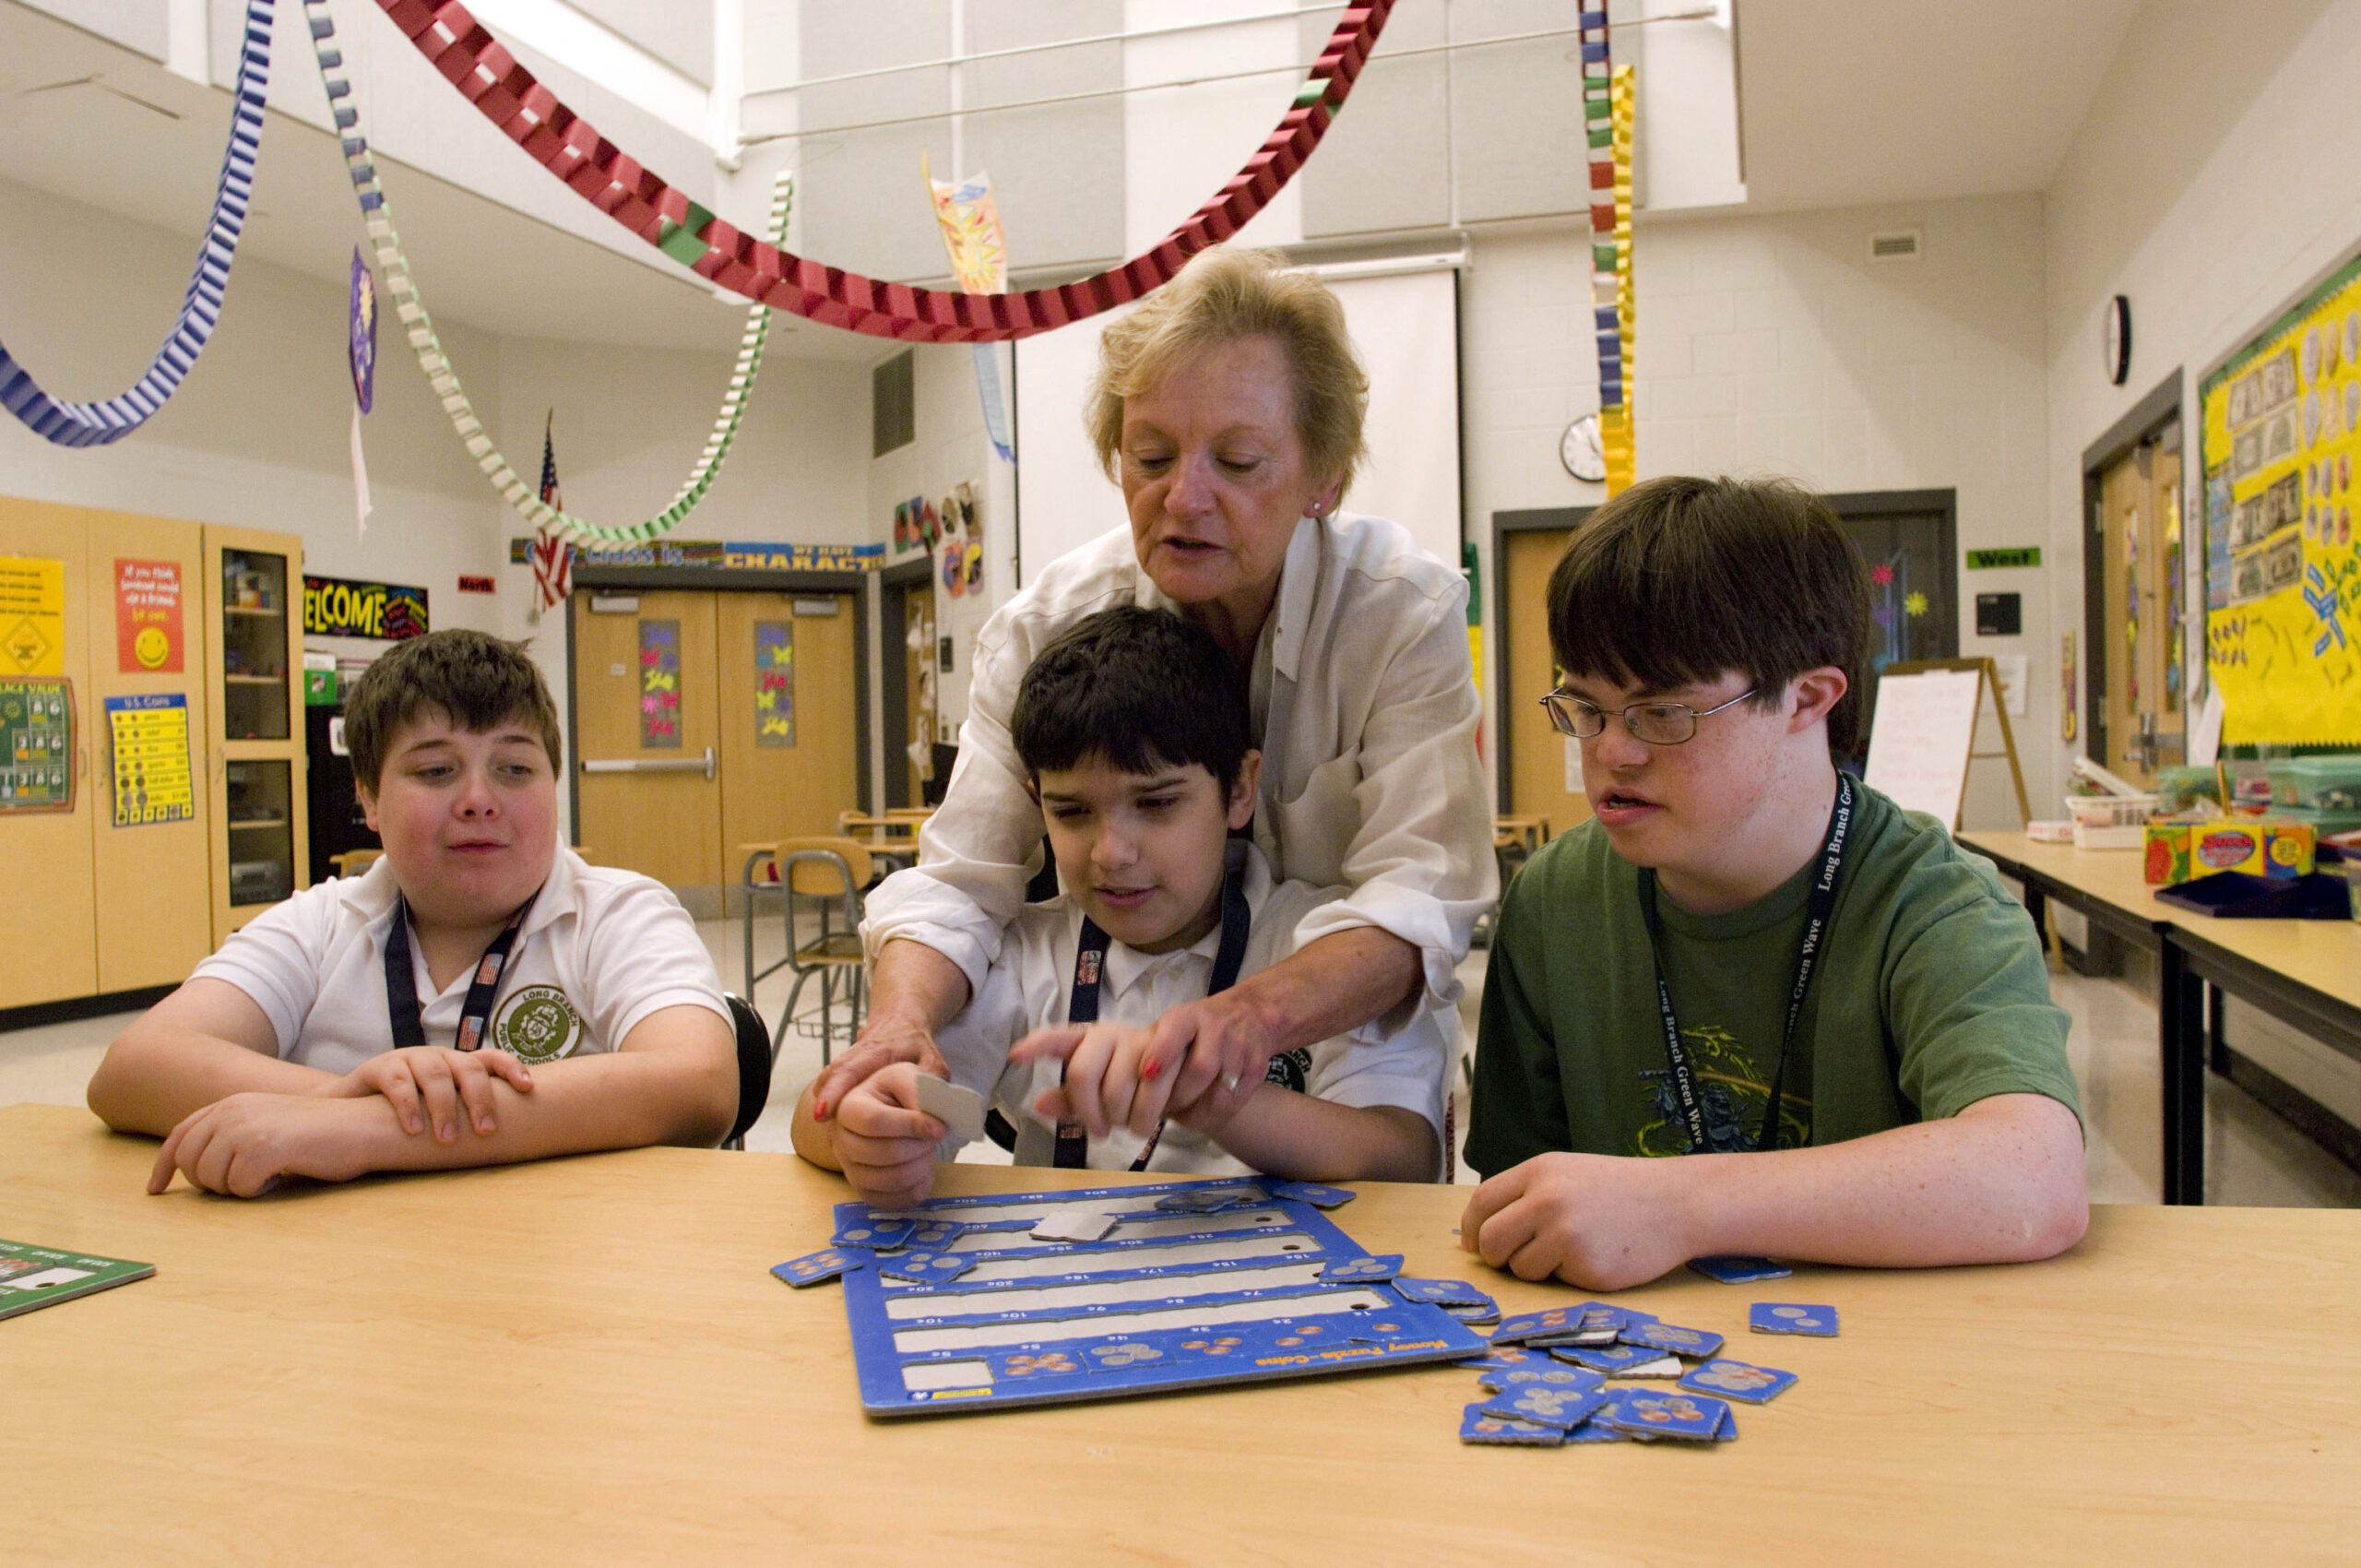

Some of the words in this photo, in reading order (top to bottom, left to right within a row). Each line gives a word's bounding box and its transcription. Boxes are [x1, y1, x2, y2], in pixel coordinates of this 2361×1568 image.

[1977, 551, 2030, 566] West
[459, 576, 492, 592] North
[303, 583, 387, 637] ELCOME
[29, 683, 61, 695] VALUE
[1828, 807, 1850, 854] Branch
[1818, 857, 1841, 892] Long
[1793, 959, 1811, 1000] Green
[1802, 919, 1821, 955] Wave
[523, 990, 550, 1002] LONG
[552, 993, 578, 1027] BRANCH
[499, 1023, 515, 1054] PUBLIC
[516, 1051, 561, 1065] SCHOOLS
[1666, 1016, 1684, 1063] Branch
[1677, 1066, 1694, 1107] Green
[1688, 1108, 1703, 1145] Wave
[1285, 1253, 1311, 1261] 15¢
[1138, 1266, 1165, 1275] 17¢
[1272, 1317, 1292, 1325] 2¢
[1352, 1310, 1372, 1318] 1¢
[1388, 1339, 1449, 1352] Money
